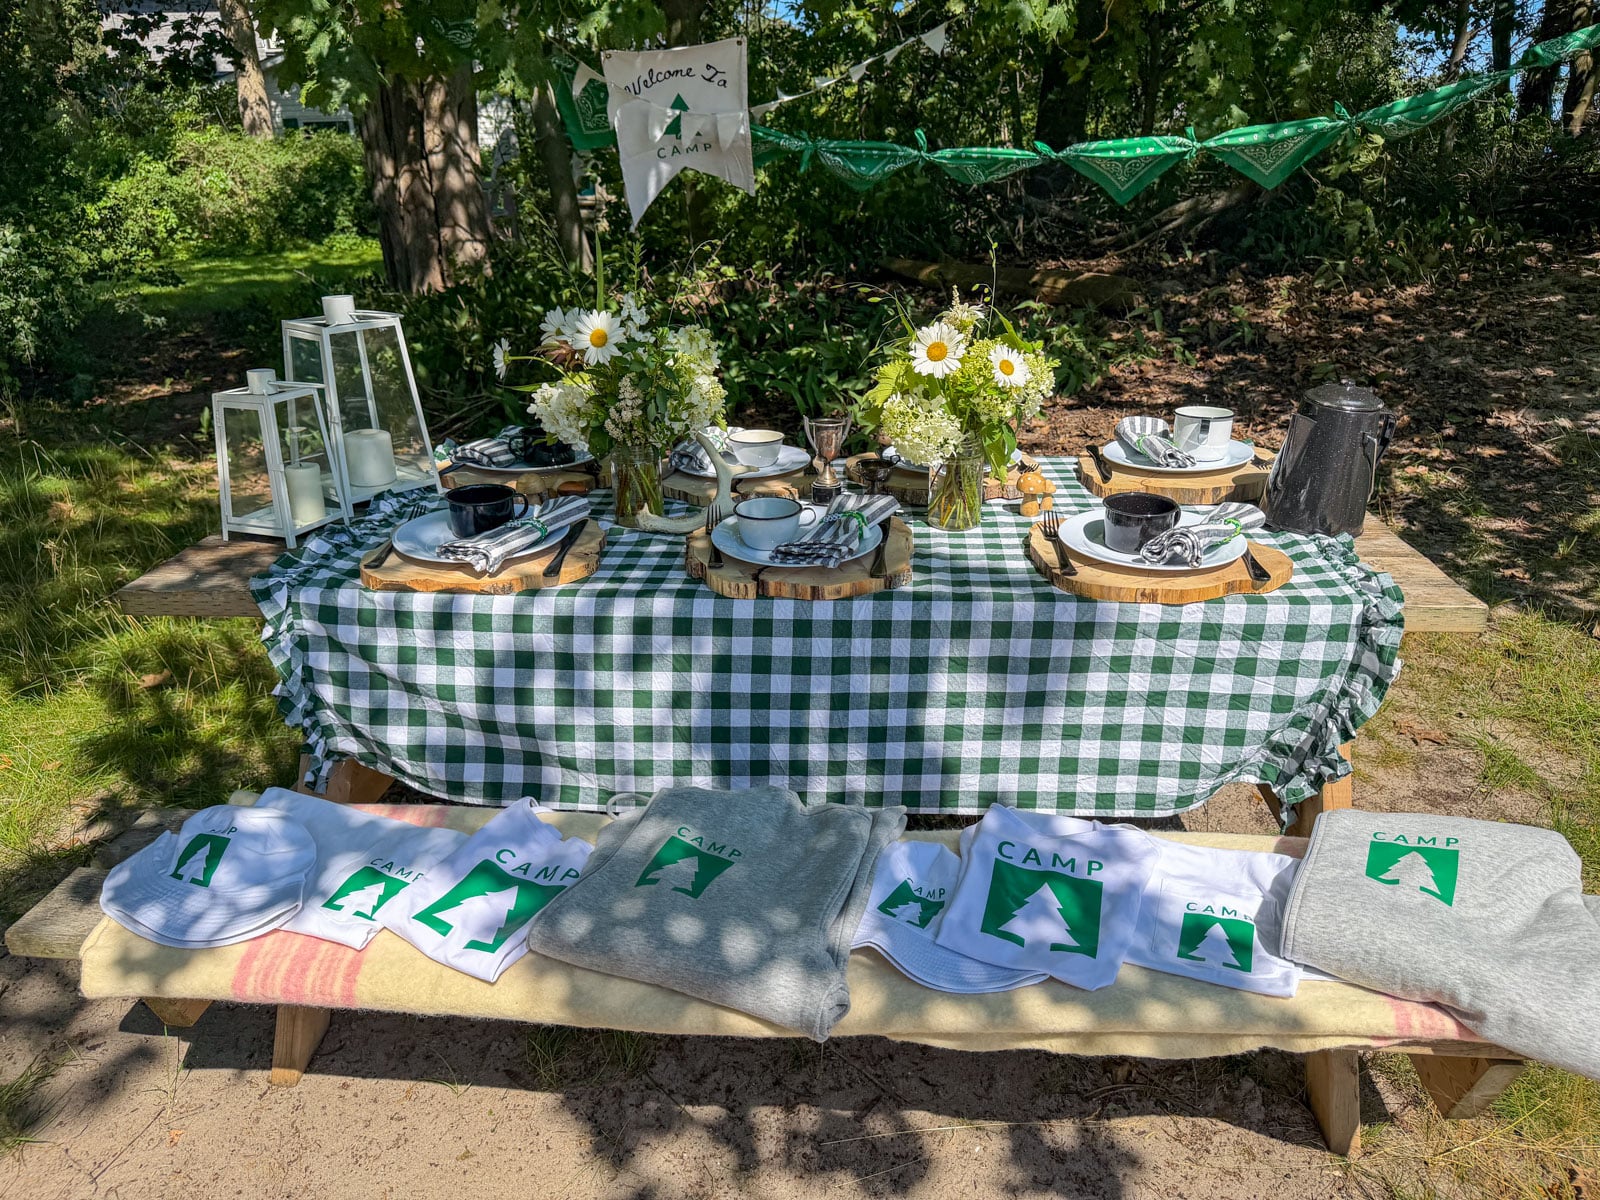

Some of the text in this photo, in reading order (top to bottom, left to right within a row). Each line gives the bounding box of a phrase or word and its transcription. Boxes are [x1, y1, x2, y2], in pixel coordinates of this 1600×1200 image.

[624, 66, 695, 95] Welcome
[656, 143, 712, 159] CAMP
[677, 826, 742, 858] CAMP
[1372, 831, 1459, 847] CAMP
[495, 848, 580, 882] CAMP
[997, 840, 1104, 876] CAMP
